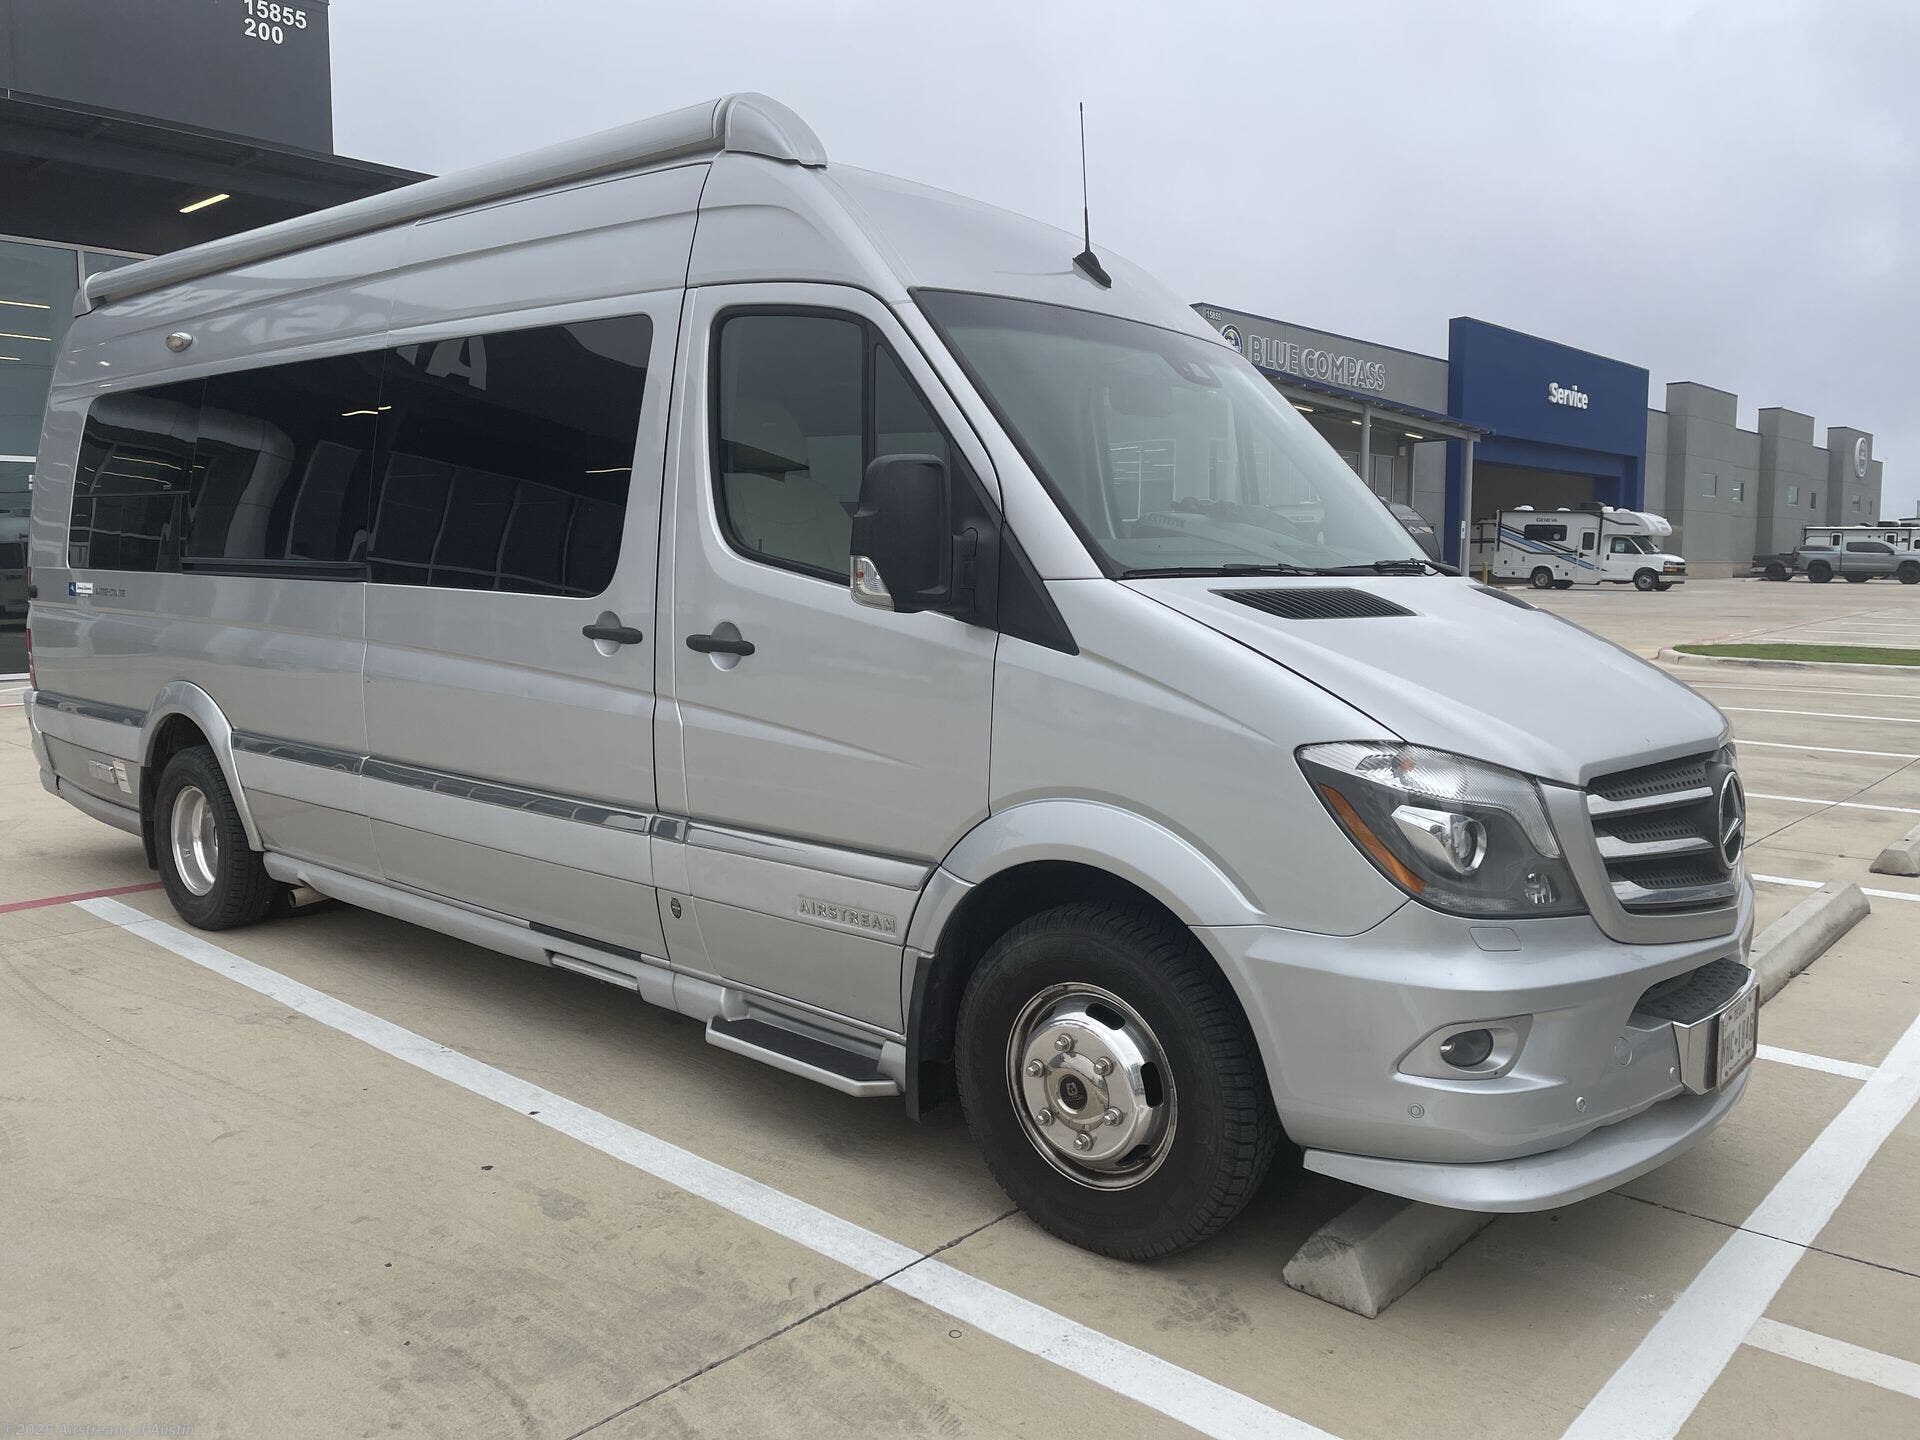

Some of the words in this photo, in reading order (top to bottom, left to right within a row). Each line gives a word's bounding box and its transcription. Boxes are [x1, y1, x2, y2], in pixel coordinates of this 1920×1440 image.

[243, 0, 307, 29] 15855
[244, 18, 284, 45] 200
[1248, 334, 1300, 375] BLUE
[1301, 347, 1386, 392] COMPASS
[1548, 382, 1589, 410] Service
[799, 898, 897, 933] AIRSTREAM
